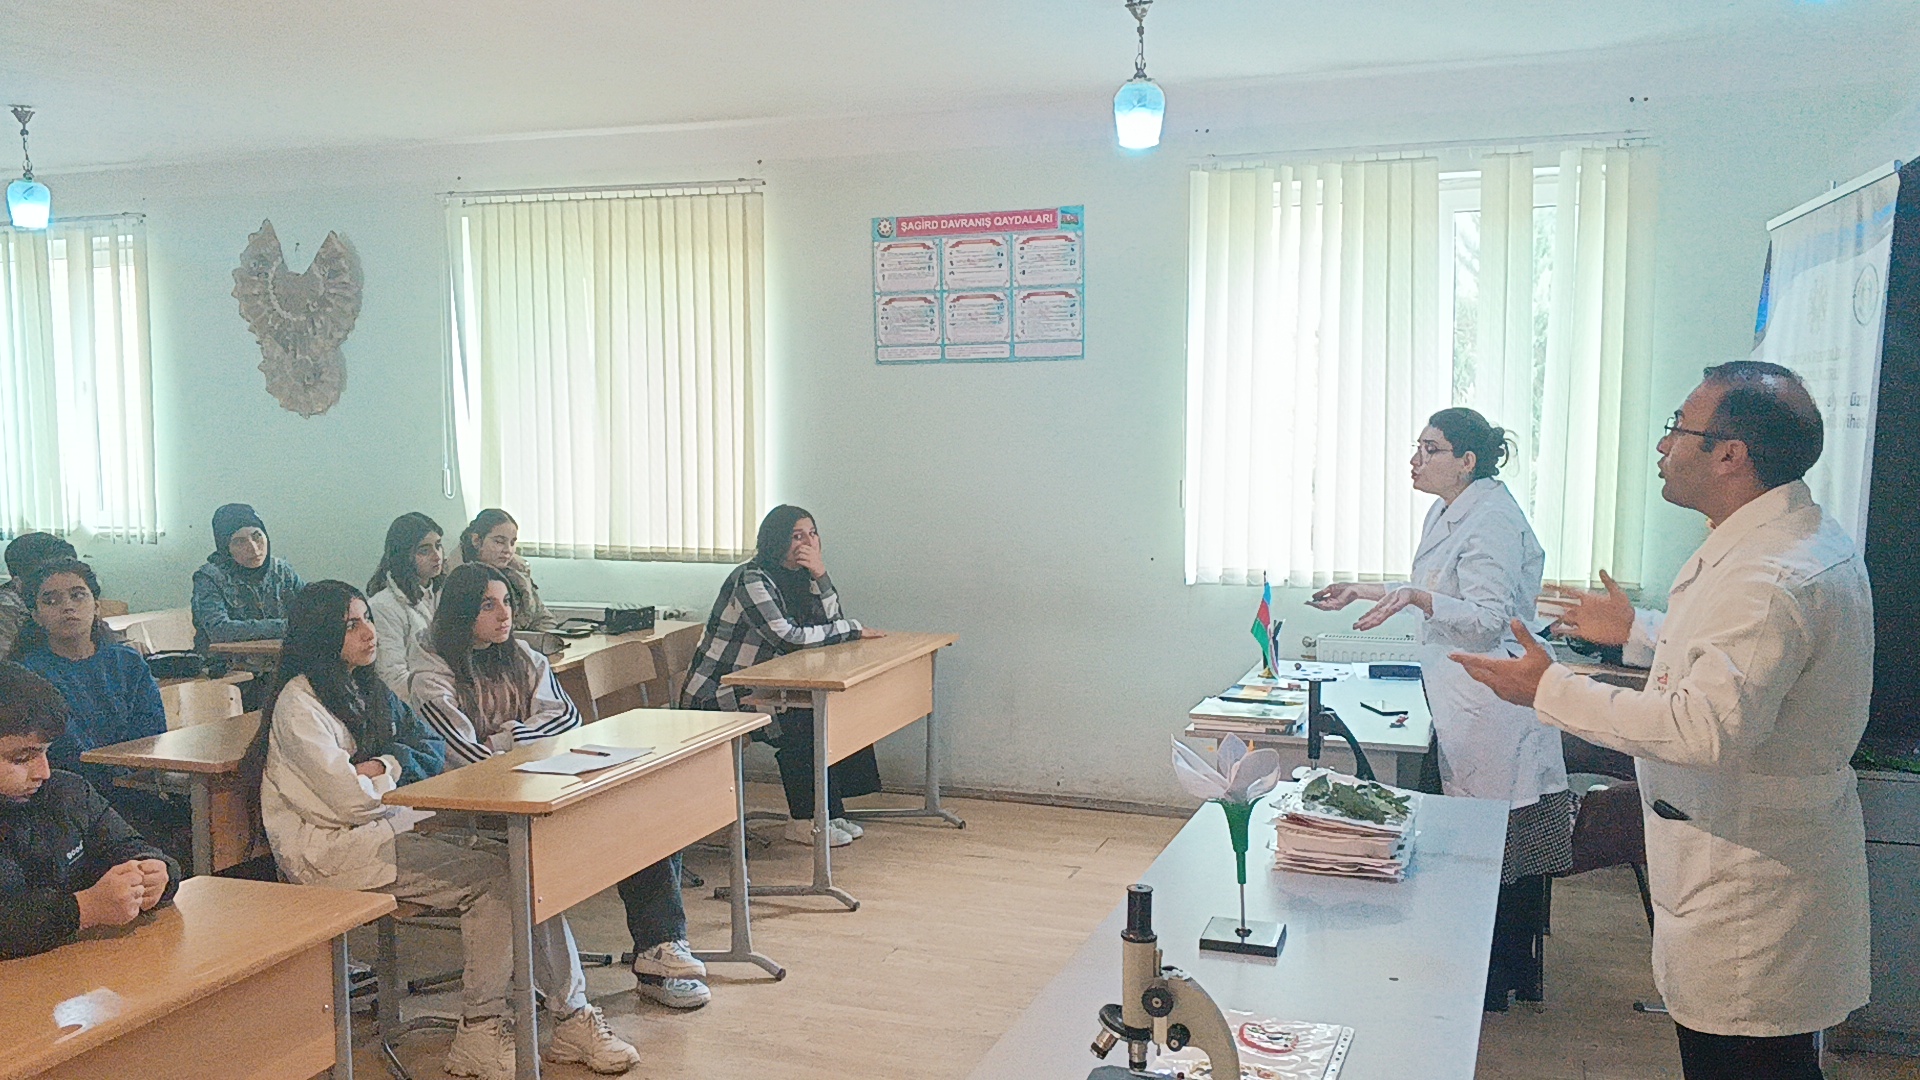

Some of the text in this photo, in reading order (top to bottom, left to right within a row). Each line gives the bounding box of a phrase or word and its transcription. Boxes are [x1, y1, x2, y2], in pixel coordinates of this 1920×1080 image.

[901, 213, 1053, 233] ŞAGİRD DAVRANIŞ QAYDALARI
